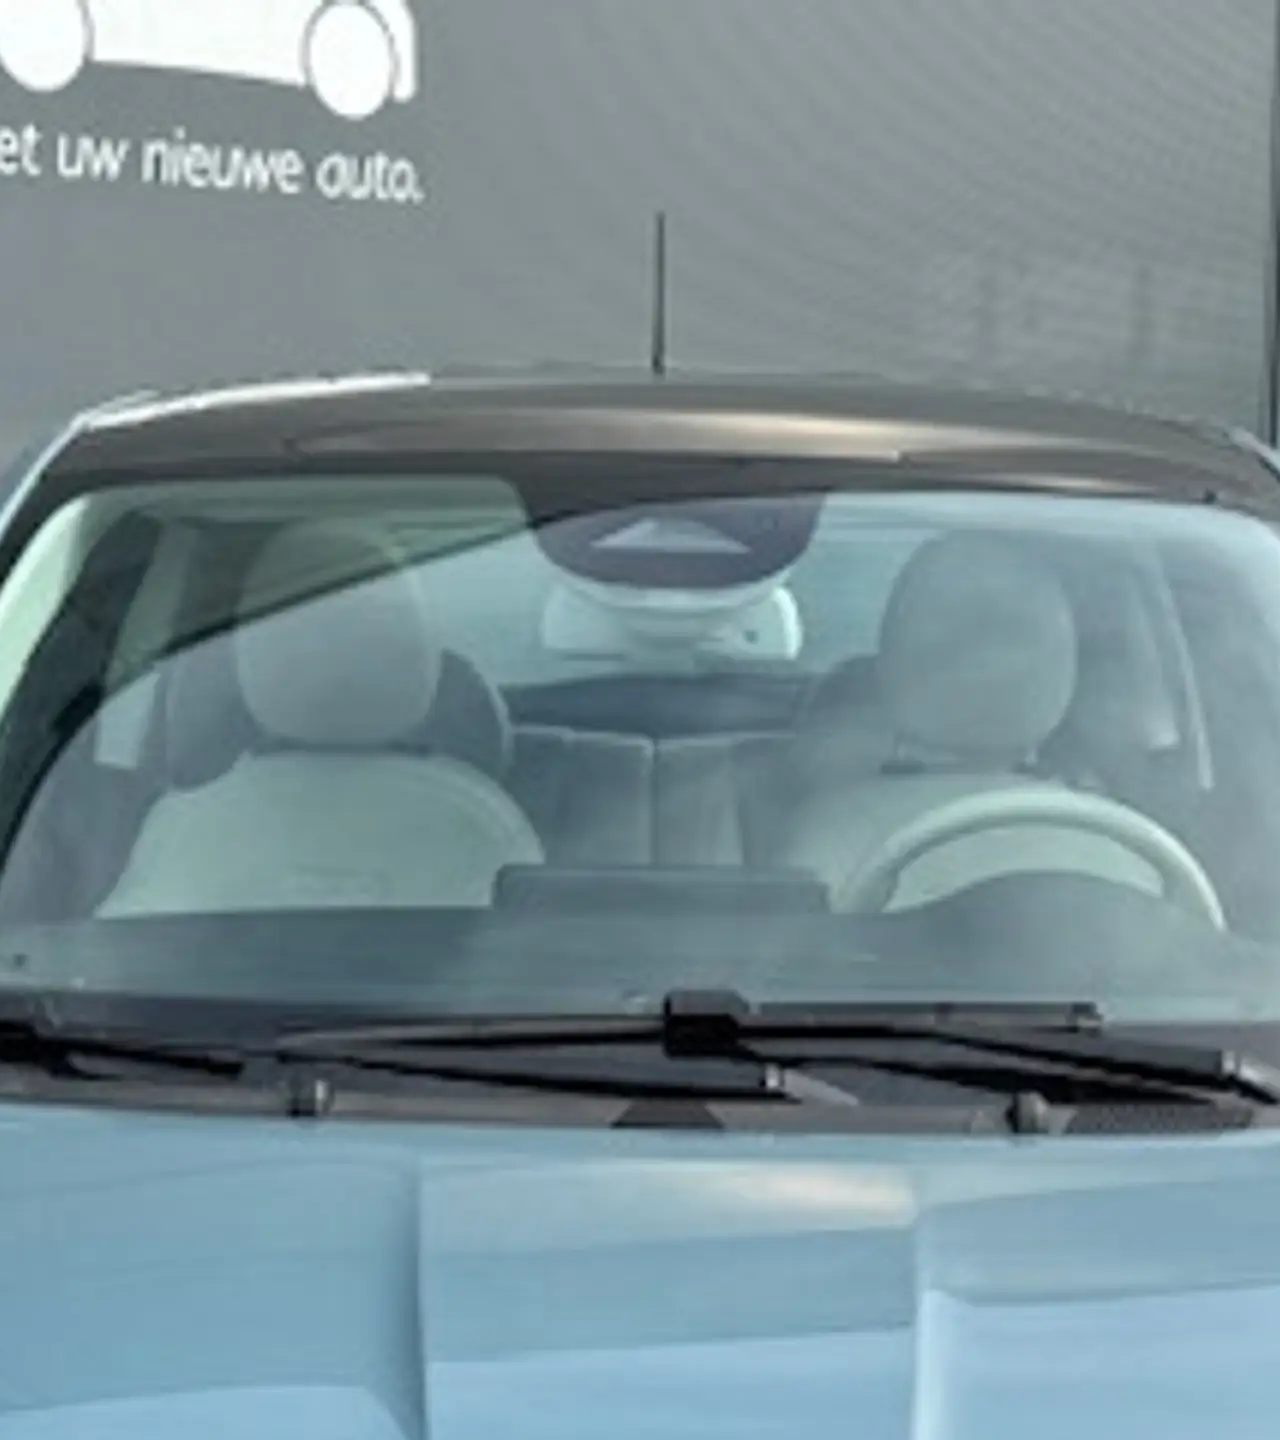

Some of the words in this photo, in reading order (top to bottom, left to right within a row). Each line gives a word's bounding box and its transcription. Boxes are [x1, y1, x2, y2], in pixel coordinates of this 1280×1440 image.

[56, 131, 131, 181] uw
[140, 125, 305, 195] nieuwe
[316, 149, 426, 204] auto.
